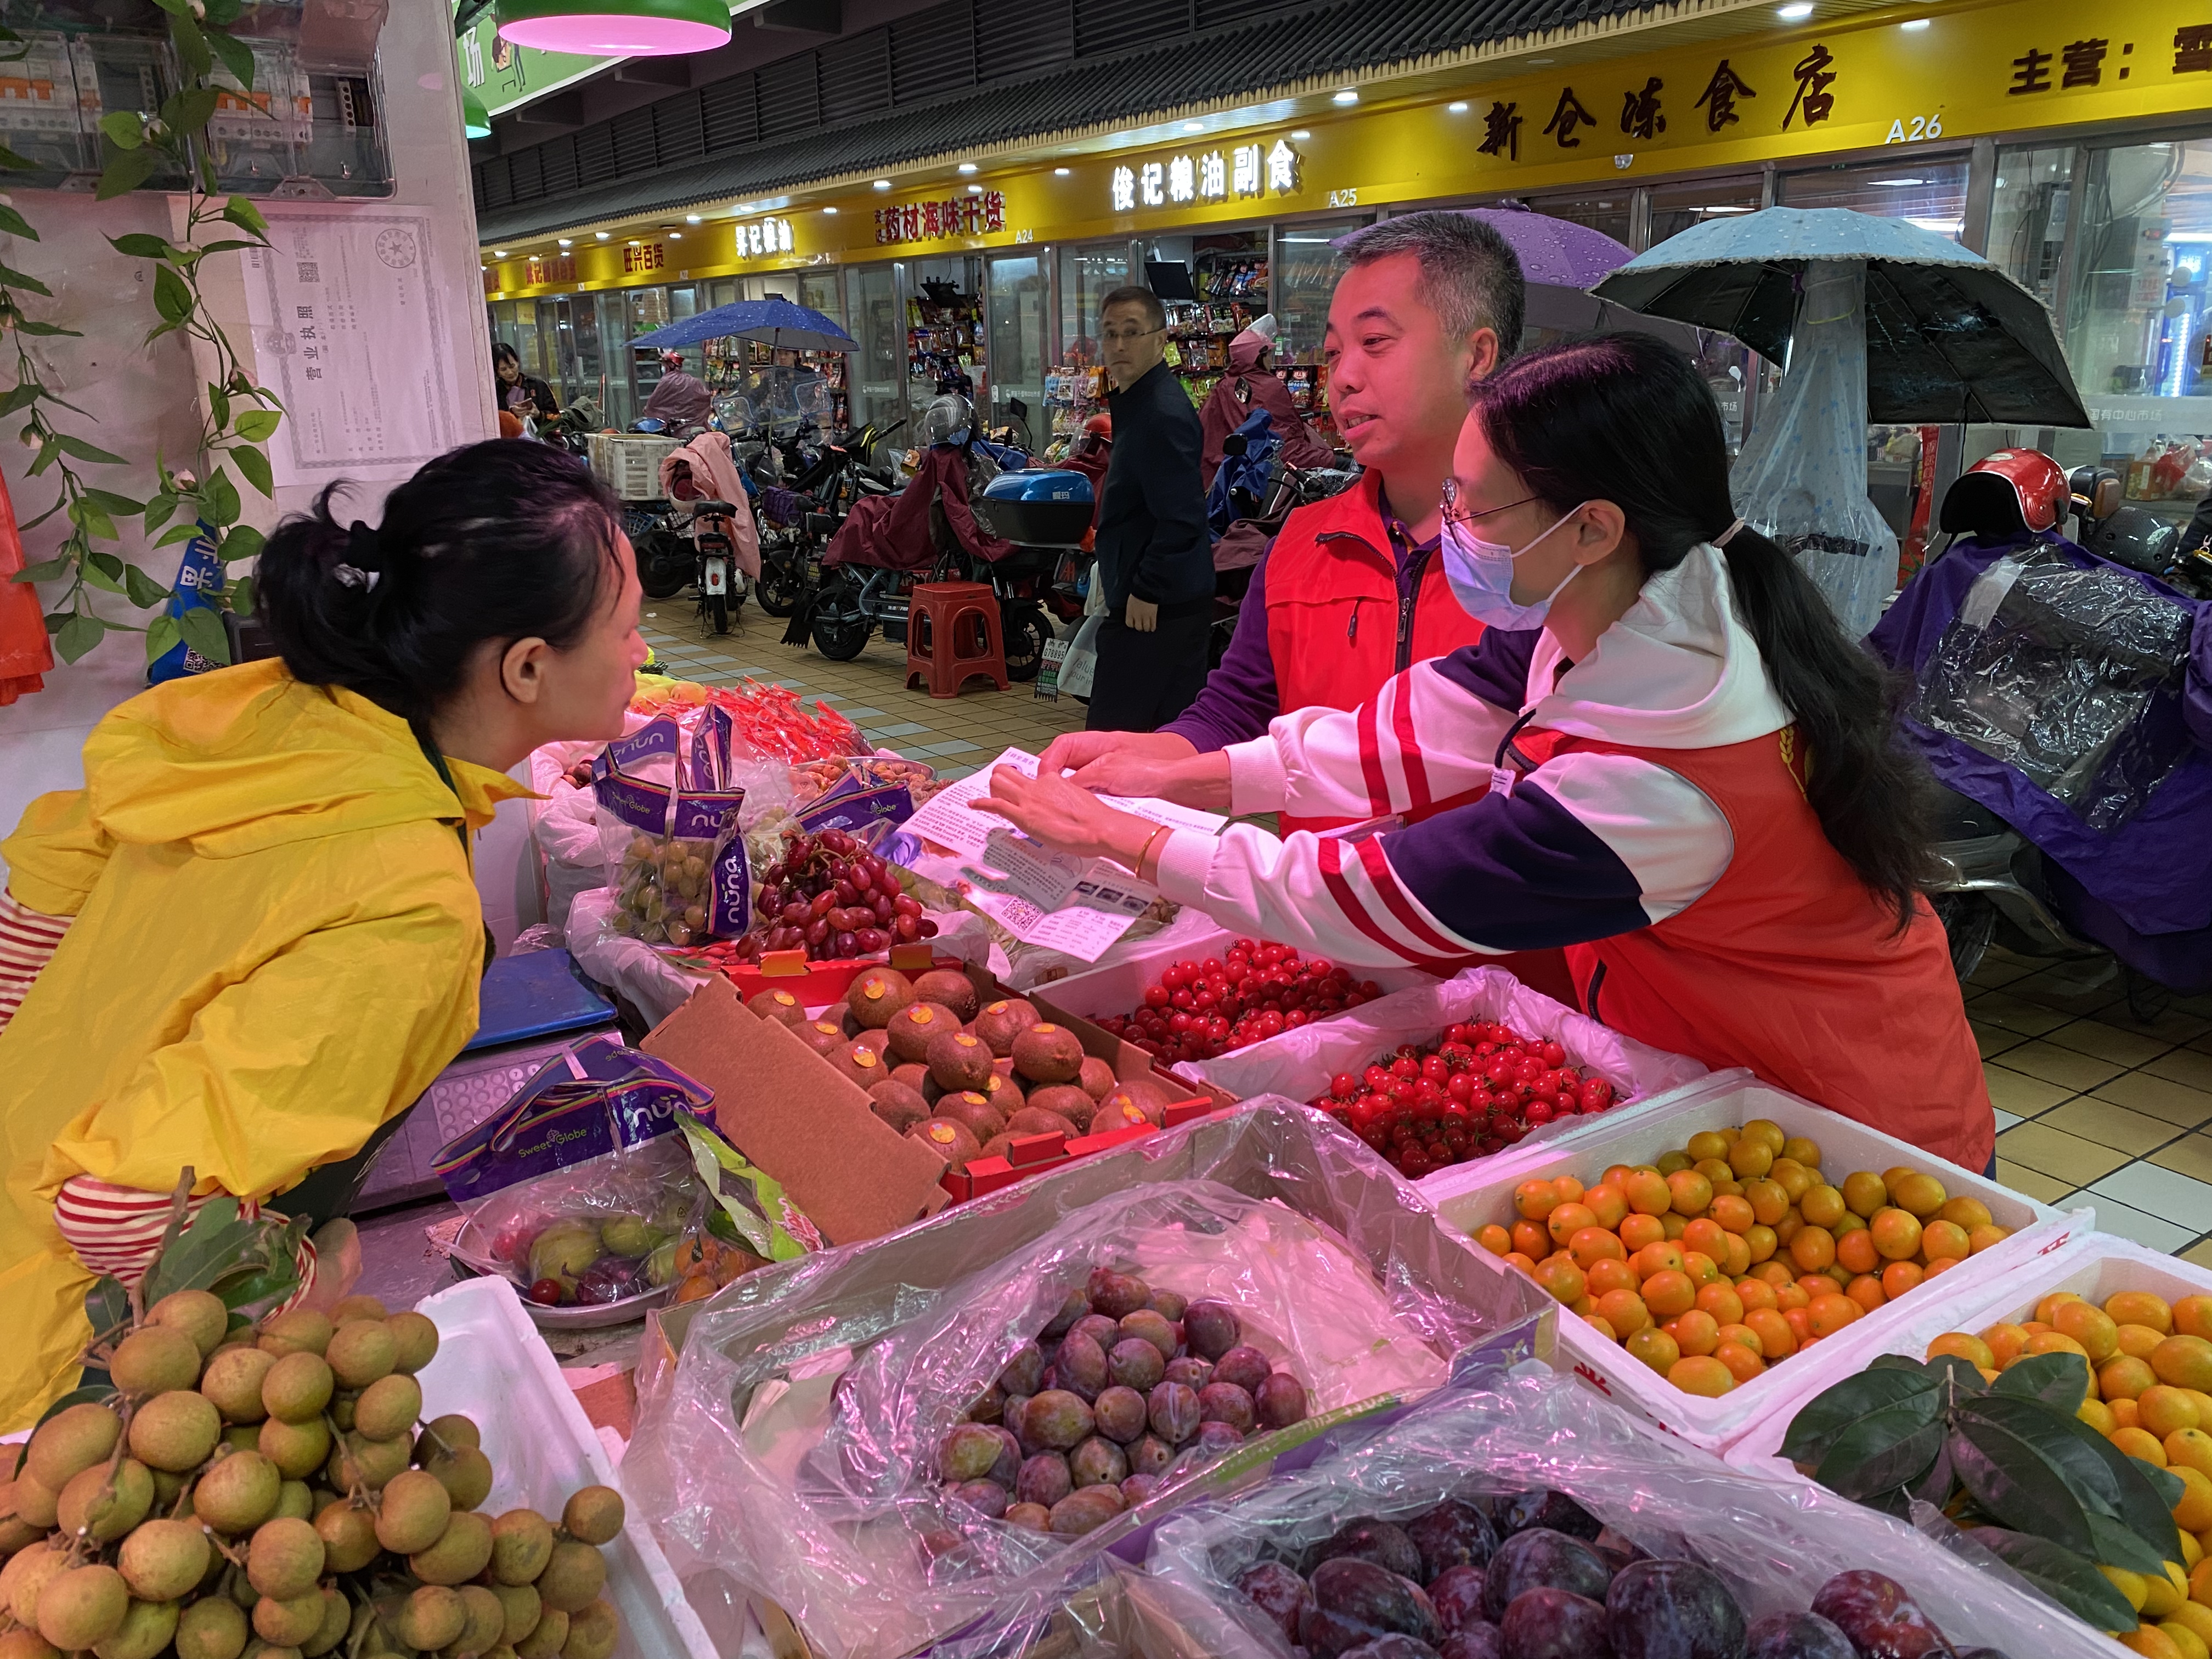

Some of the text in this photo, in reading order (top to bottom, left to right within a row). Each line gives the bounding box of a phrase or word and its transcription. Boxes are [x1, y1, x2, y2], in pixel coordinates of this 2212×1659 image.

[1884, 114, 1943, 144] A26
[1113, 139, 1296, 212] 俊记粮油副食
[1328, 188, 1358, 208] A25
[884, 190, 1006, 241] 药材海味干货
[1015, 228, 1034, 244] A24
[623, 243, 664, 273] 旺兴百货
[296, 305, 323, 381] 营业执照
[2090, 408, 2162, 422] 国有中心市场
[1043, 647, 1065, 661] G78895
[629, 800, 651, 815] Globe
[874, 803, 897, 815] Globe
[518, 1128, 588, 1159] Sweet Globe
